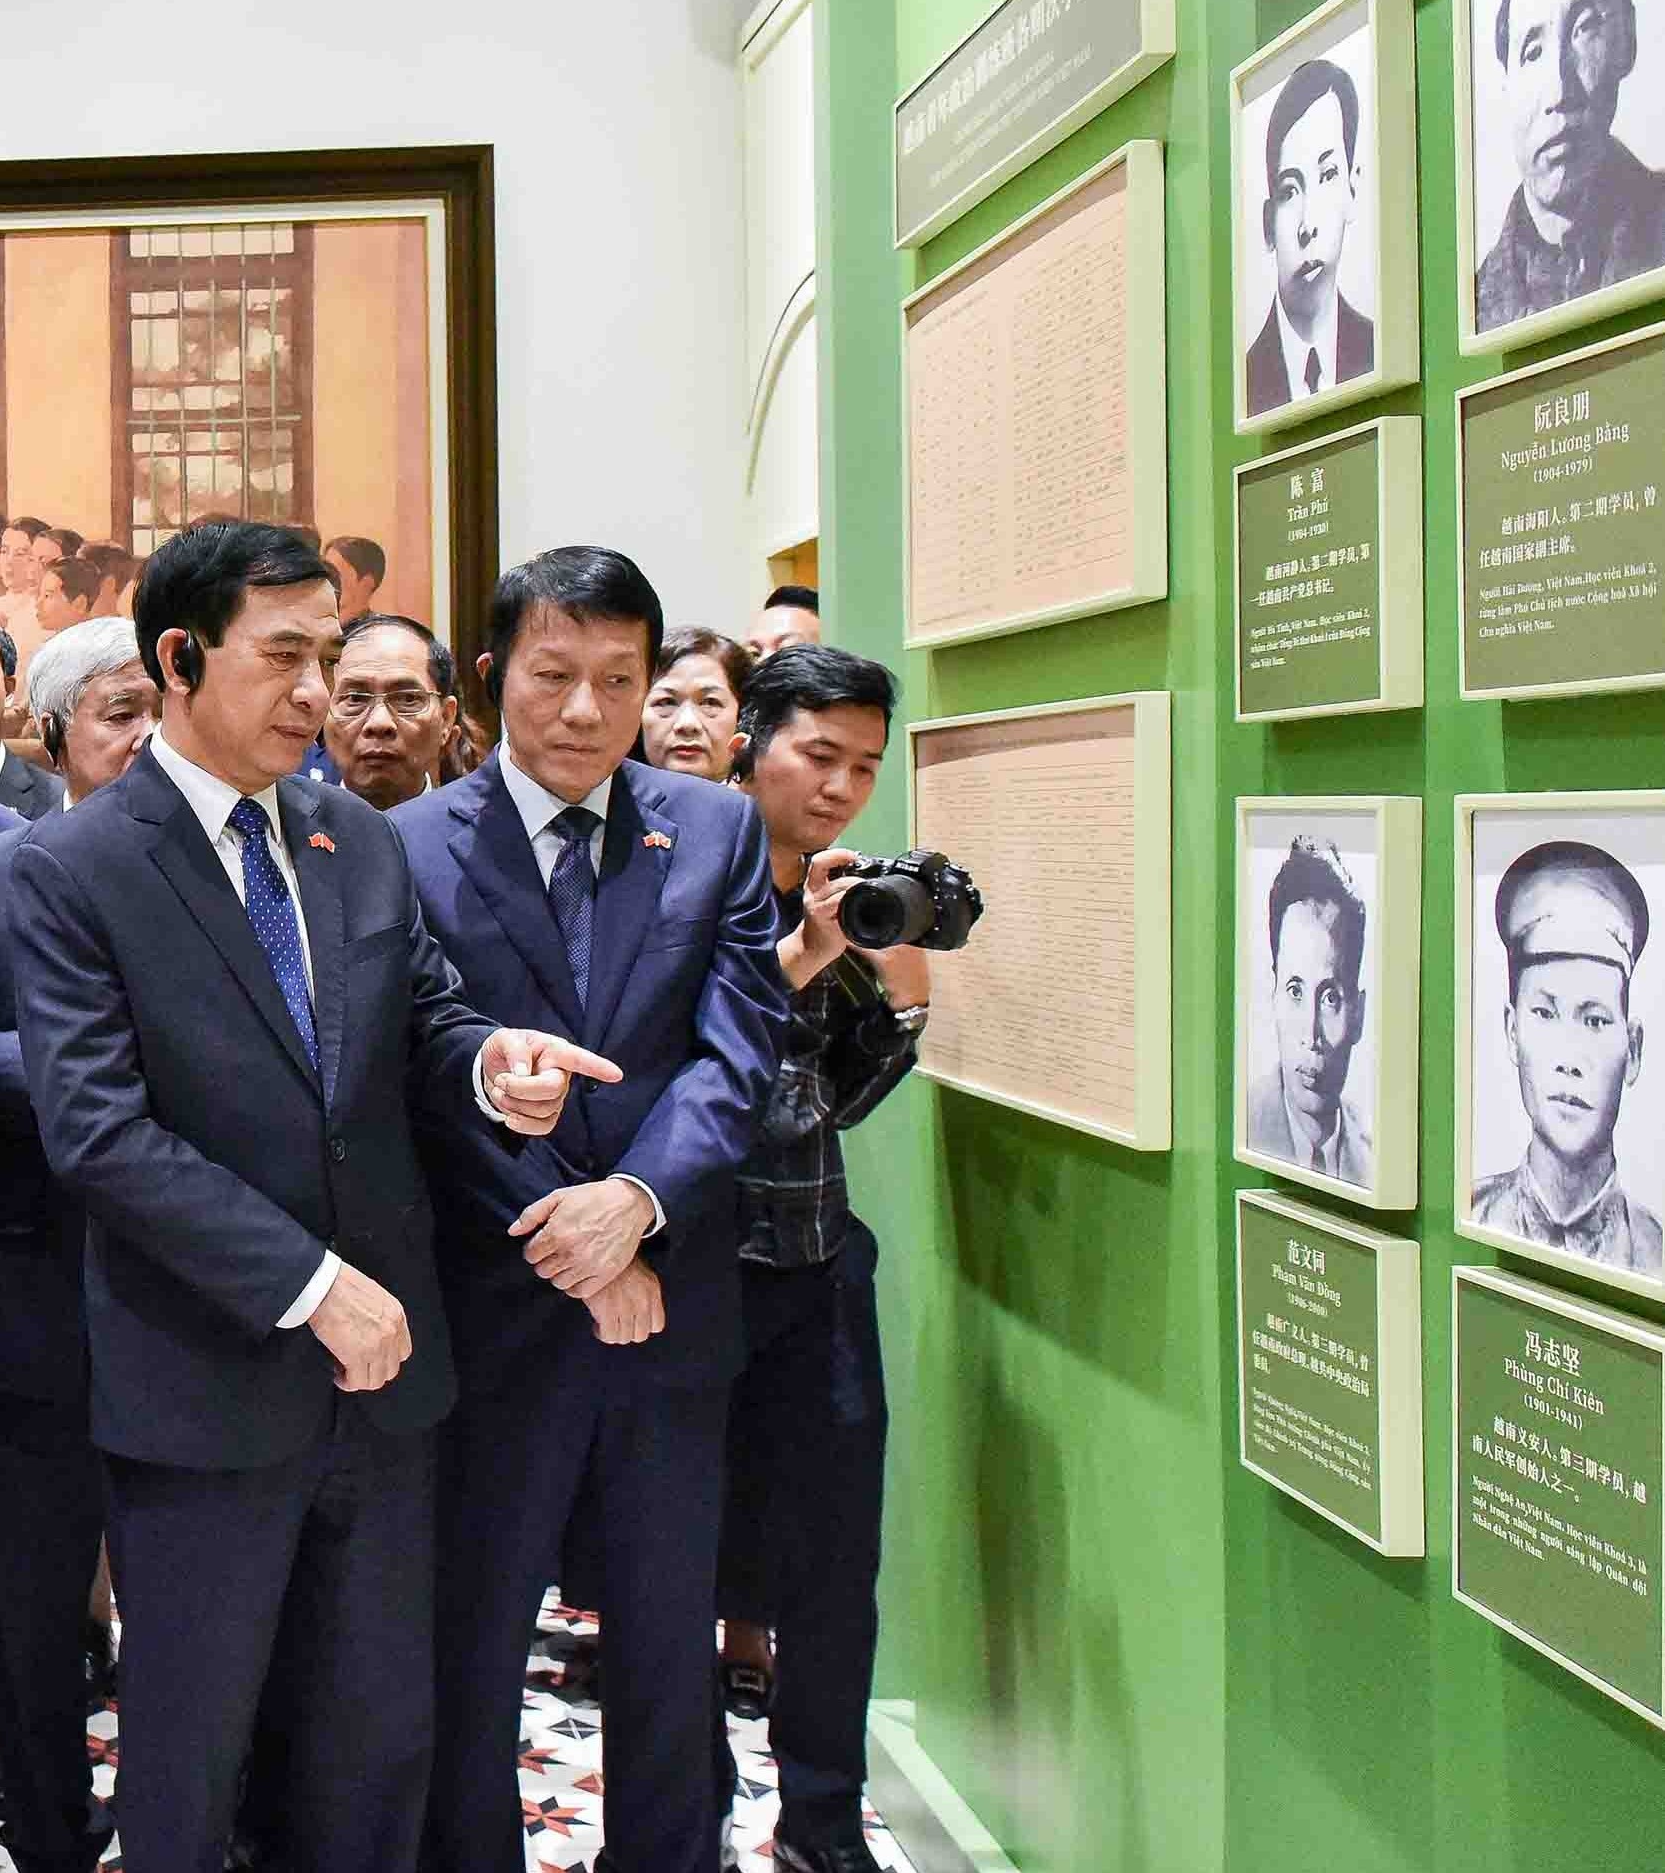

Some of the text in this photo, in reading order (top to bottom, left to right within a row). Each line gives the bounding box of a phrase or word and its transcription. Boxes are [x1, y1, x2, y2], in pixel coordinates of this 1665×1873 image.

[1534, 390, 1590, 432] 阮良朋
[1501, 442, 1547, 471] Nguyễn
[1551, 434, 1591, 456] Lương
[1534, 456, 1593, 483] (1904-1979)
[1525, 1330, 1582, 1378] 冯志坚
[1504, 1357, 1544, 1394] Phùng
[1573, 1385, 1604, 1415] Kiên
[1523, 1393, 1583, 1431] (1901-1941)
